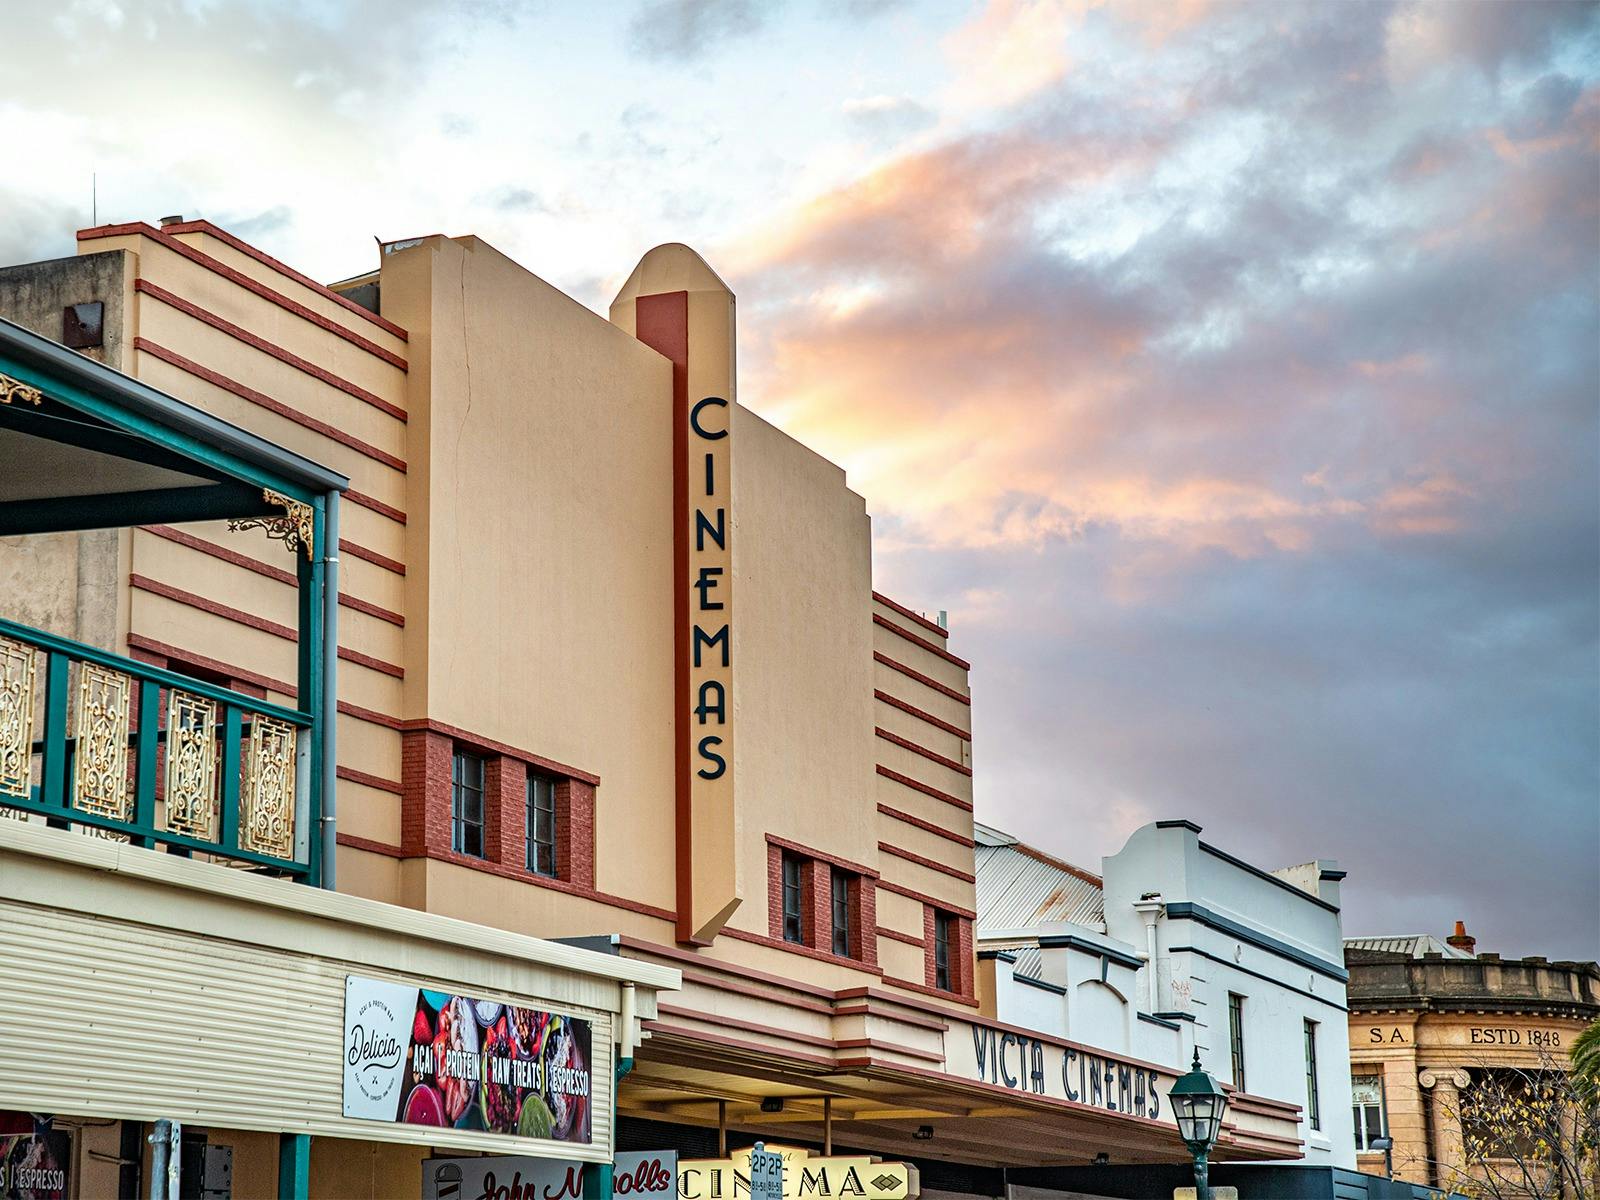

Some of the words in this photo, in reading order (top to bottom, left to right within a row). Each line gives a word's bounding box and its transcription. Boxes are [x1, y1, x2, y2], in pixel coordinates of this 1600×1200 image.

[690, 397, 729, 780] CINEMAS
[348, 1024, 402, 1072] Delicia
[1470, 1028, 1521, 1045] ESTD.
[1527, 1030, 1561, 1047] 1848
[446, 1051, 480, 1081] PROTEIN
[492, 1056, 510, 1085] RAW
[512, 1059, 542, 1090] TREATS
[553, 1065, 589, 1096] ESPRESSO
[972, 1025, 1046, 1094] VICTA
[1062, 1049, 1160, 1120] CINEMAS
[19, 1168, 65, 1191] ESPRESSO
[752, 1154, 767, 1173] 2P
[768, 1156, 783, 1175] 2P
